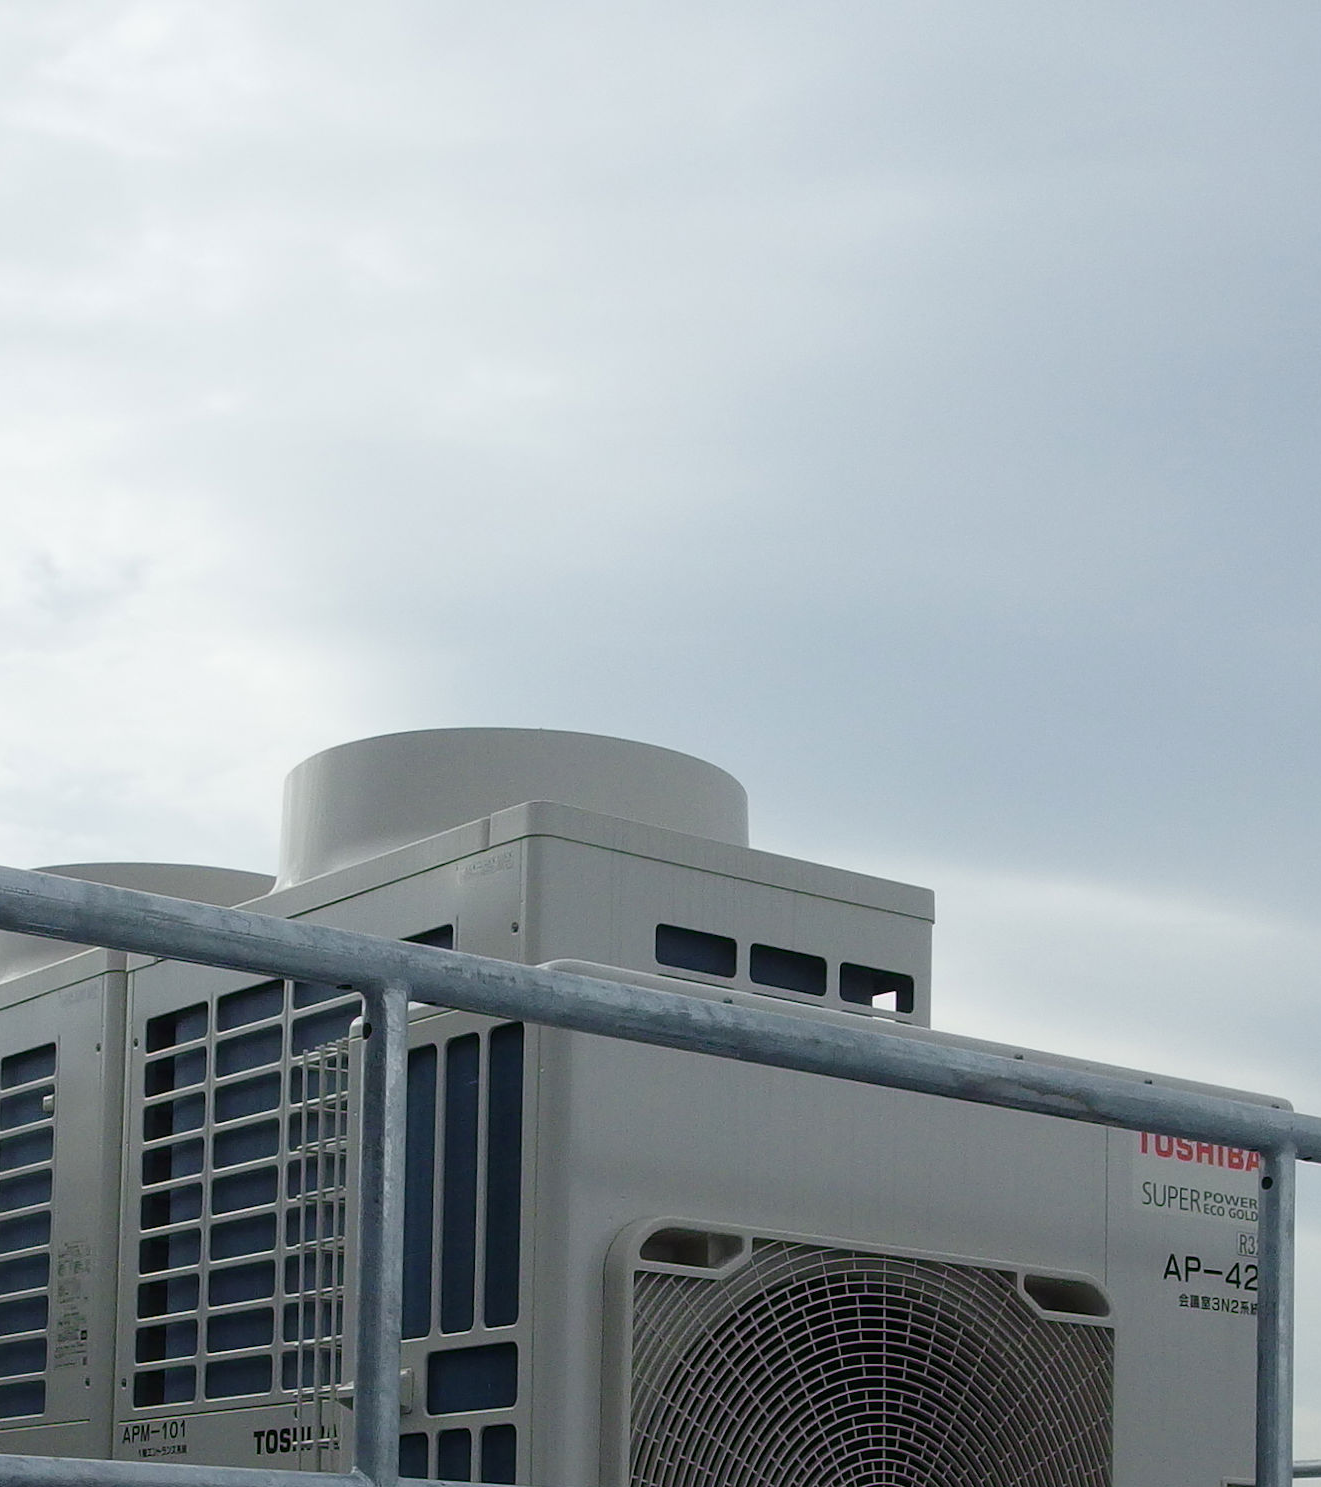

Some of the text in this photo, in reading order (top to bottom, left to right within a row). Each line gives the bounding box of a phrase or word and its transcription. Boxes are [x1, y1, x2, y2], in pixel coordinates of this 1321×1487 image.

[1141, 1131, 1259, 1172] TOSHIBA
[1142, 1181, 1201, 1213] SUPER
[1203, 1191, 1258, 1209] POWER
[1203, 1204, 1258, 1222] ECO GOLD
[1239, 1234, 1258, 1255] R3
[1163, 1253, 1258, 1291] AP-42
[122, 1419, 186, 1444] APM-101
